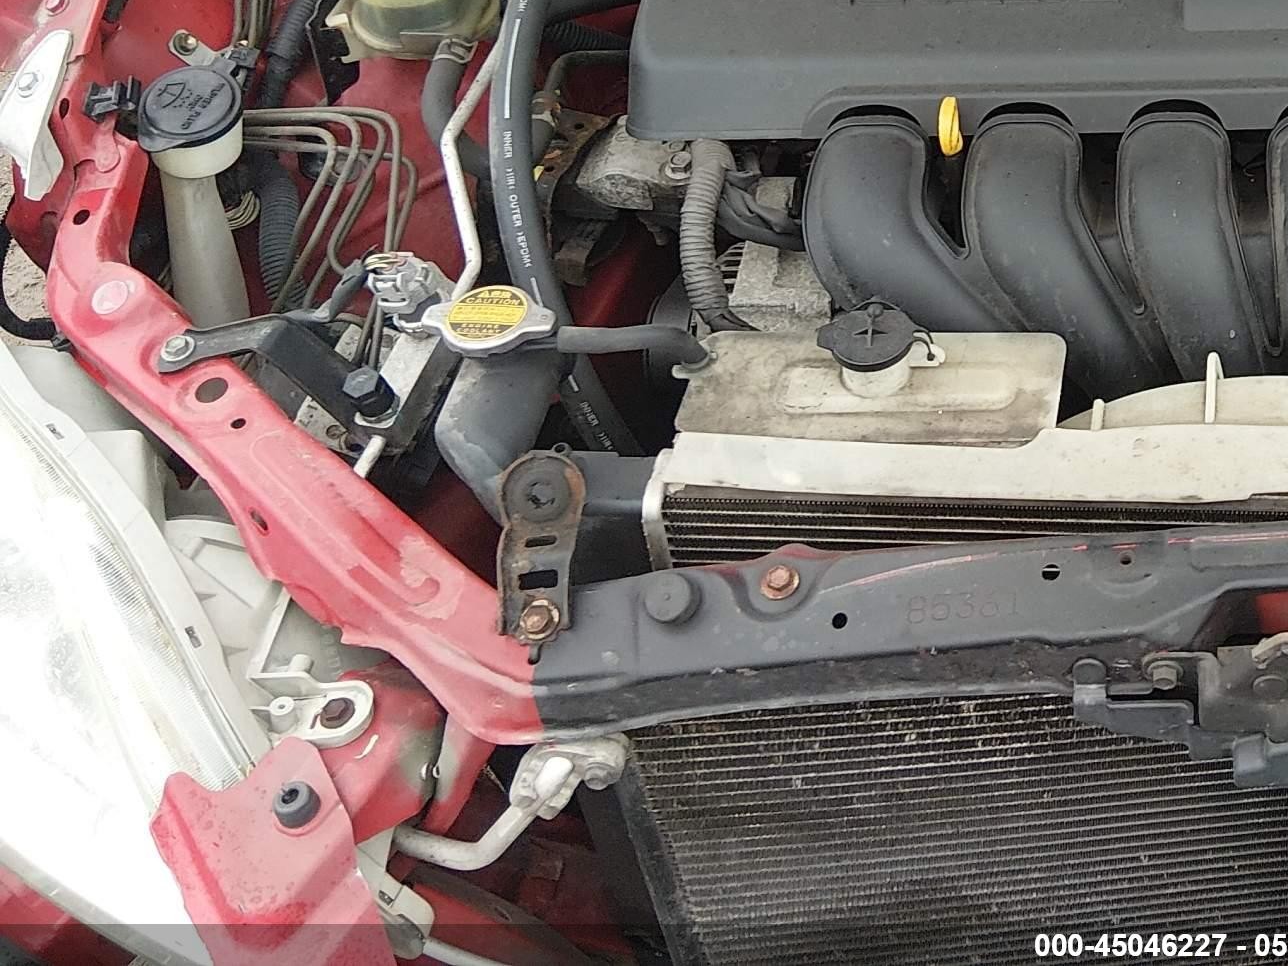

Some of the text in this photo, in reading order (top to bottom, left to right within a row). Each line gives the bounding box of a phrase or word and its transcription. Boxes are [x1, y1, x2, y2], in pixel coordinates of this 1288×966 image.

[504, 131, 513, 158] INNER
[509, 195, 522, 227] OUTER
[466, 297, 520, 305] CAUTION
